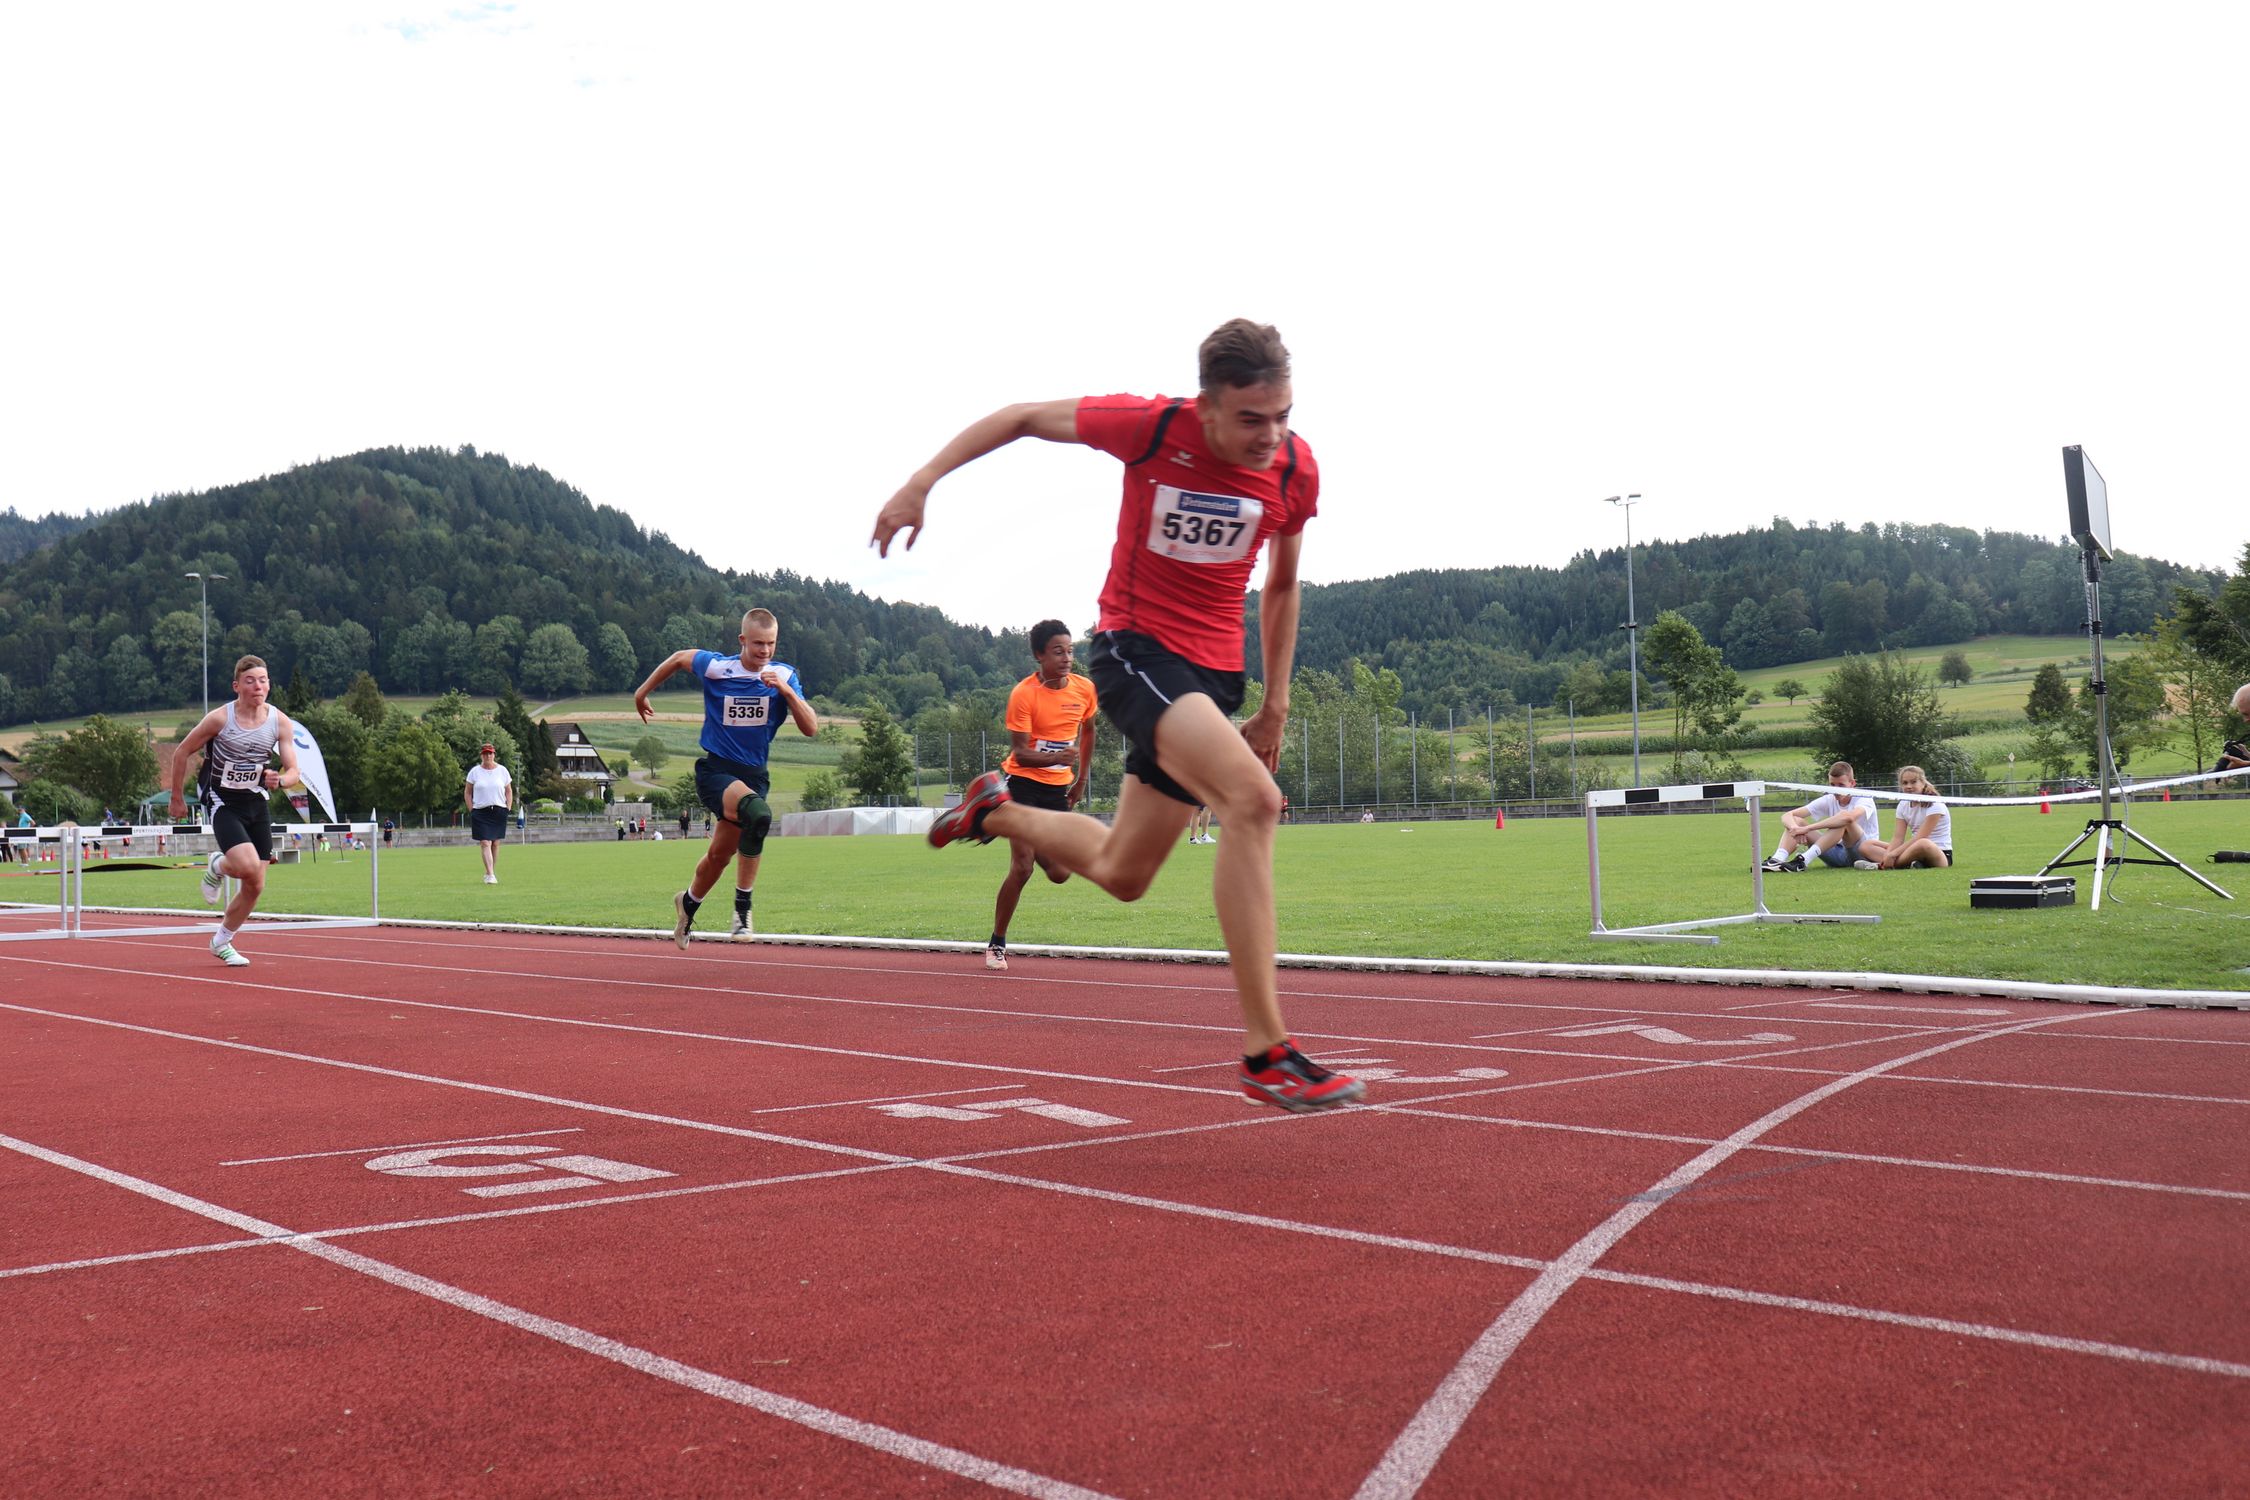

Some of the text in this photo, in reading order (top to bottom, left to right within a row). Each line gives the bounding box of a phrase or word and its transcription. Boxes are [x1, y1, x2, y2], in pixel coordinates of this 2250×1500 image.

[1162, 512, 1247, 546] 5367
[728, 706, 764, 718] 5336
[226, 771, 257, 782] 5350
[1548, 1023, 1798, 1045] 2
[868, 1096, 1134, 1128] 4
[363, 1144, 679, 1198] 5
